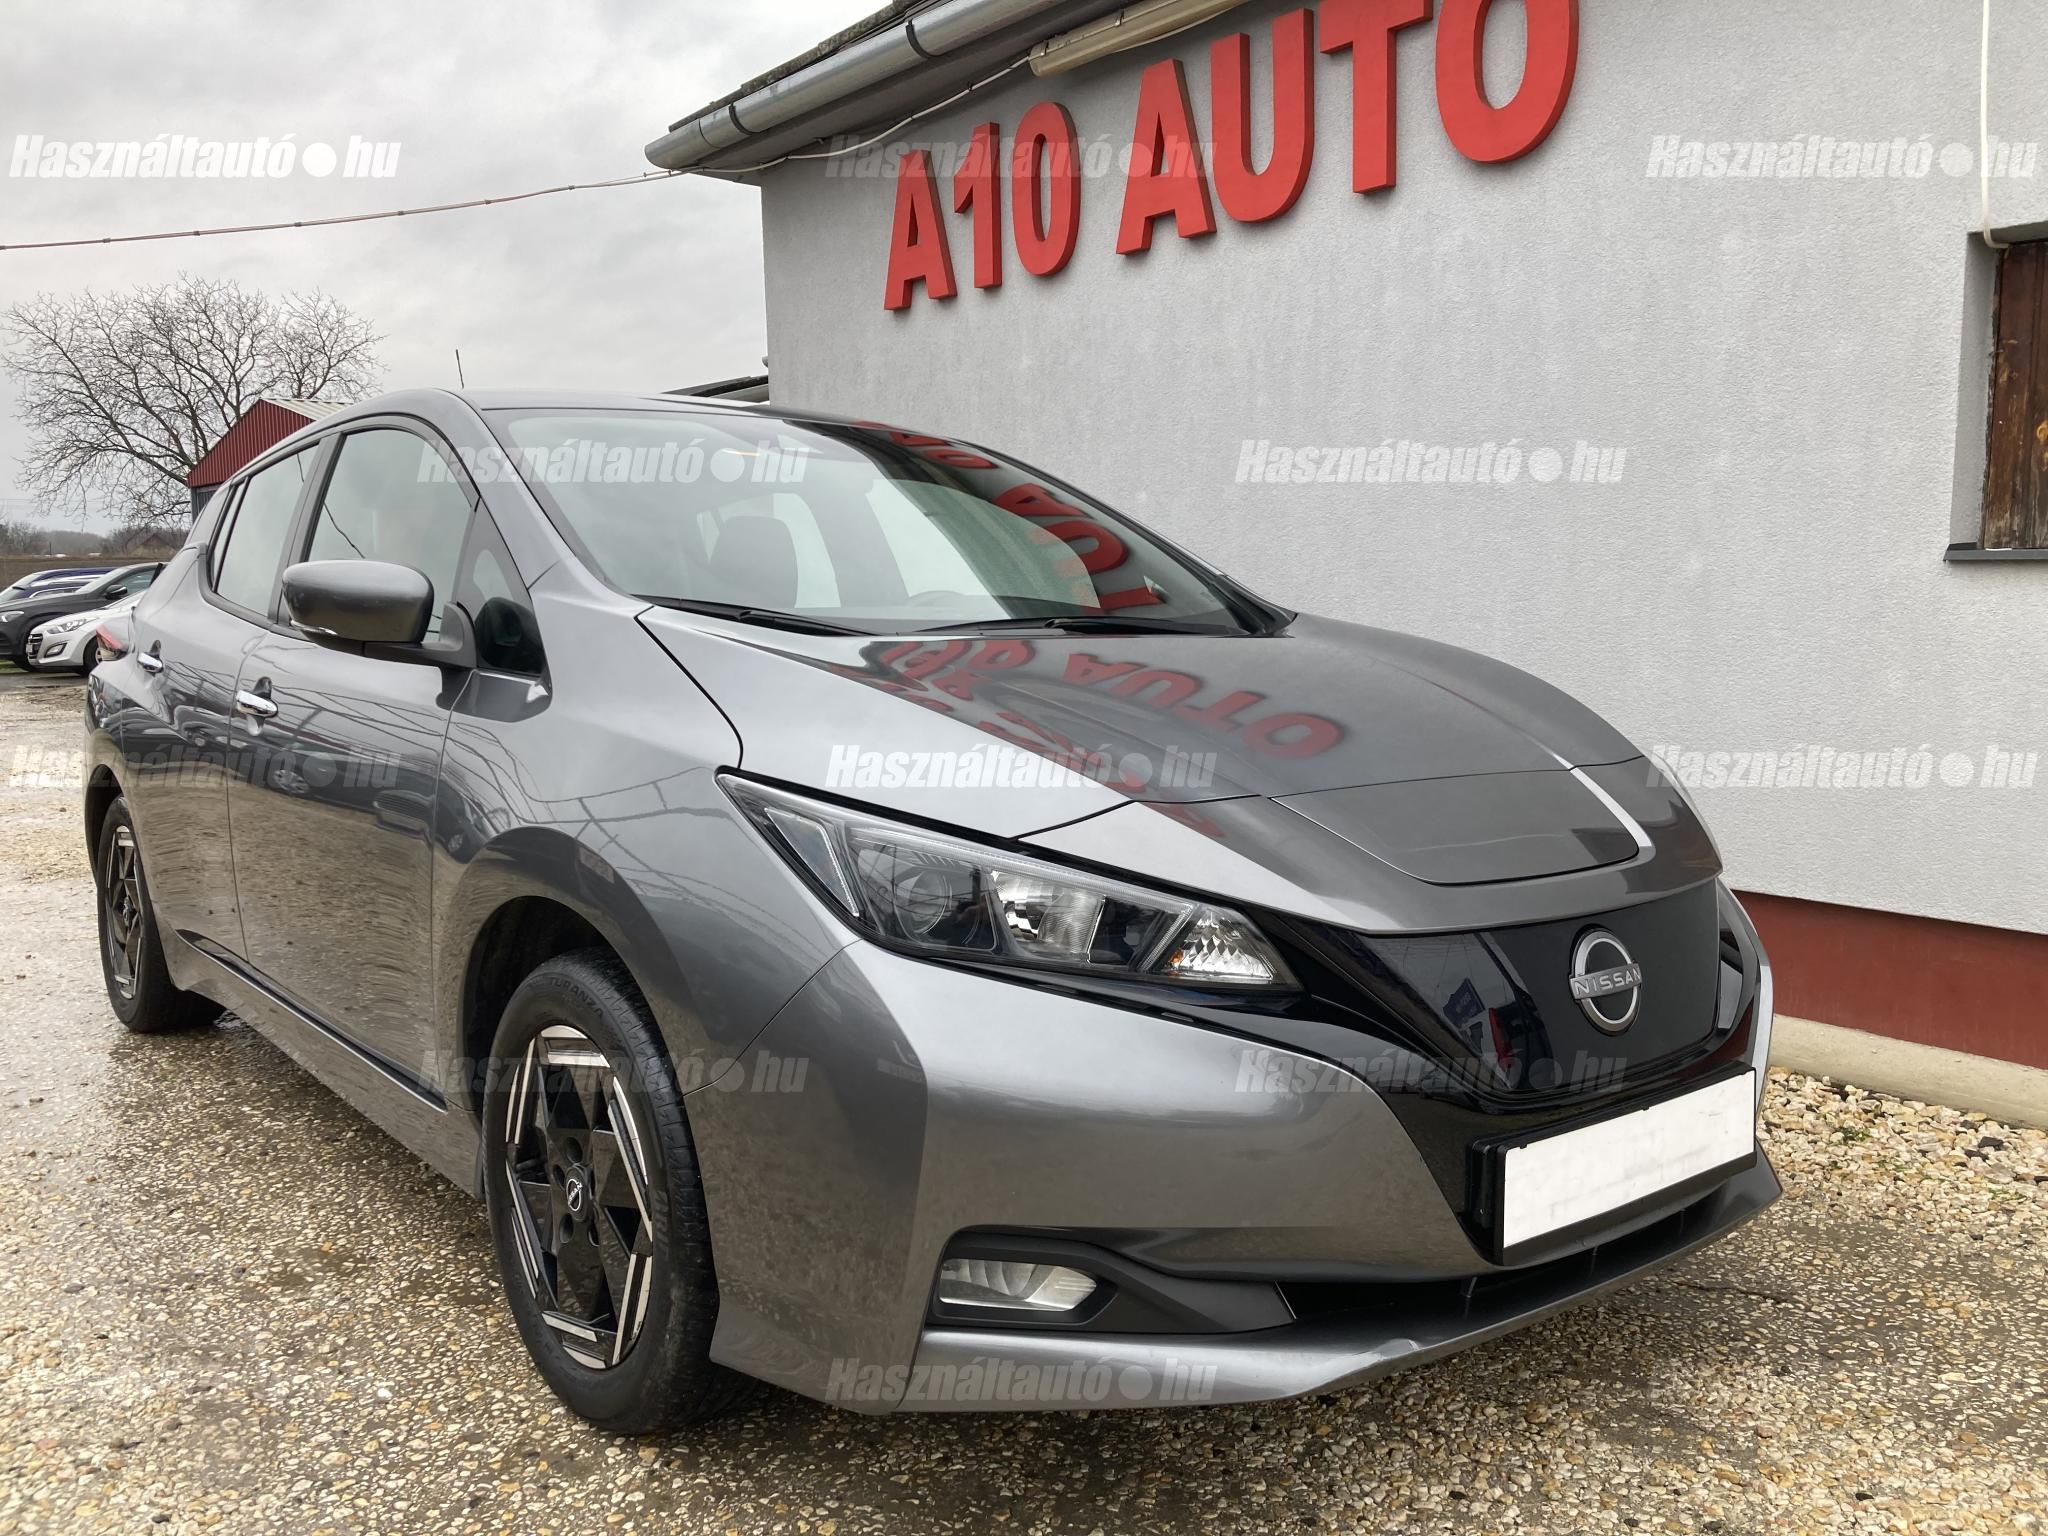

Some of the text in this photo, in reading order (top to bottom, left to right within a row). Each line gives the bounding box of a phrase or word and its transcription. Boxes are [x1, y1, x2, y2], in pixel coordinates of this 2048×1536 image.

[884, 0, 1580, 312] A10 AUTO
[1574, 967, 1641, 995] NISSAN
